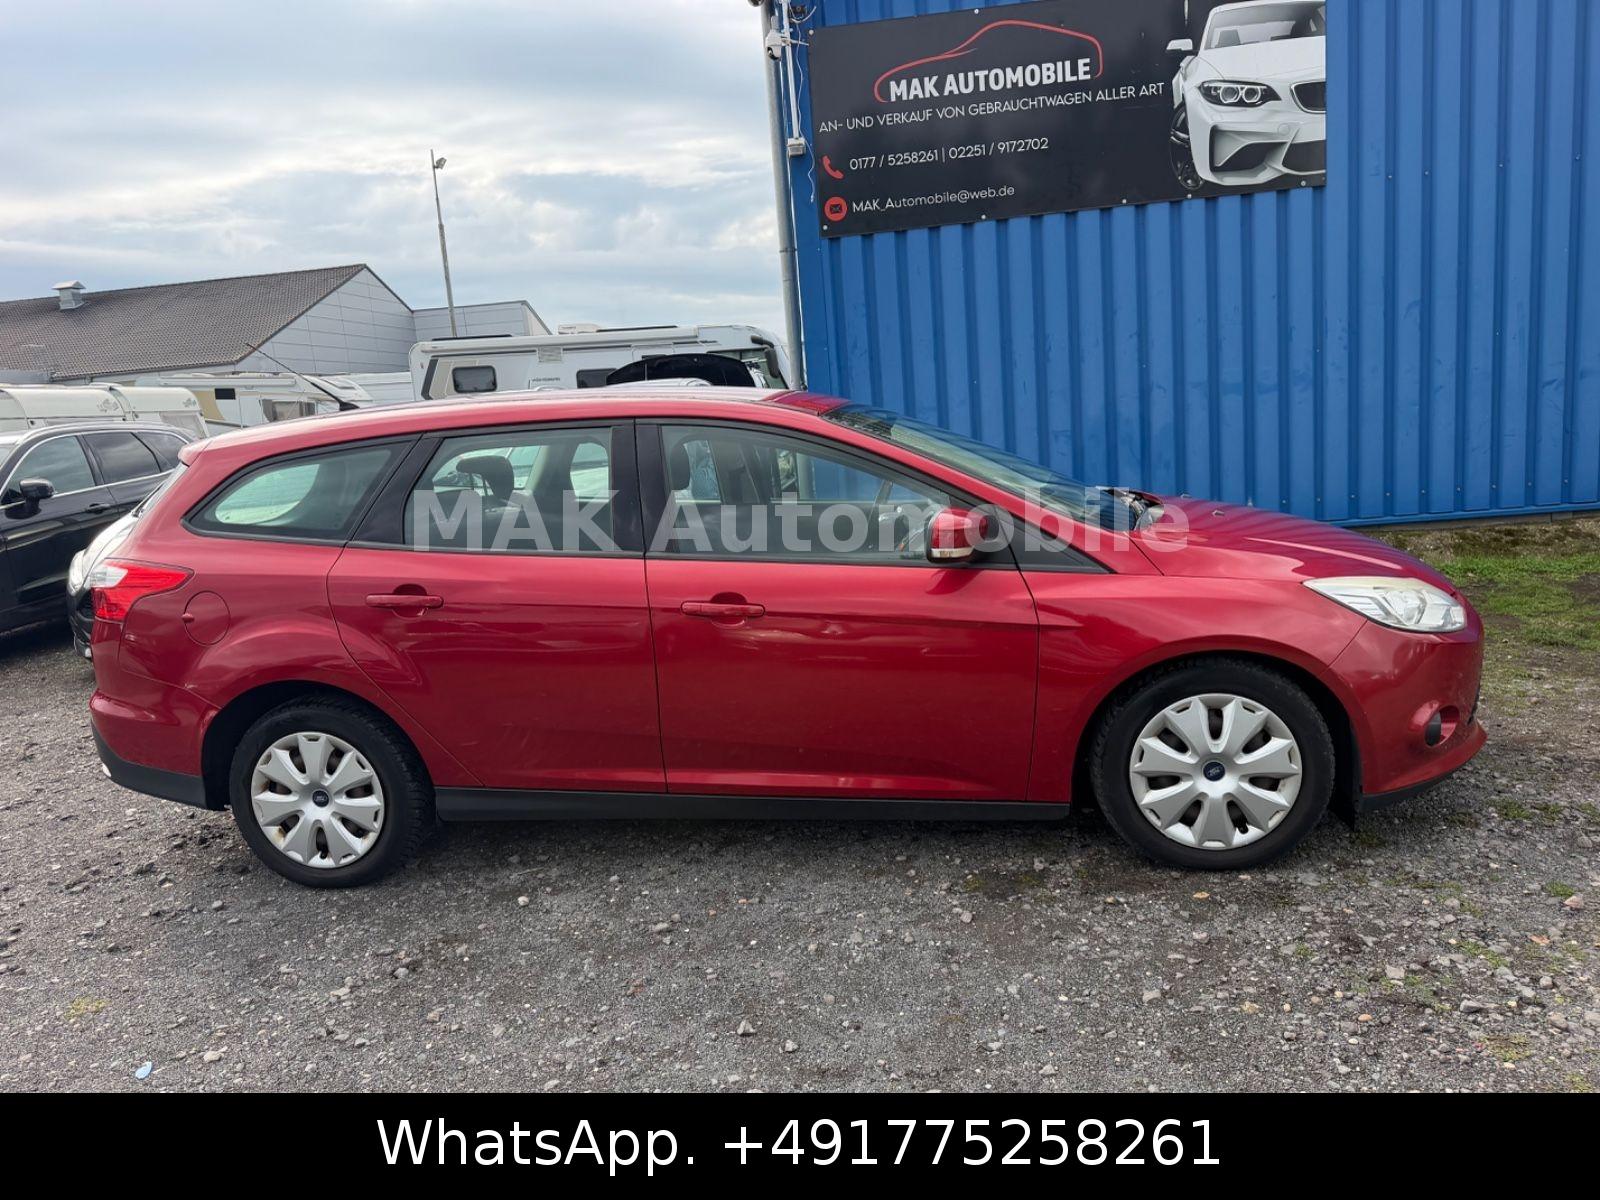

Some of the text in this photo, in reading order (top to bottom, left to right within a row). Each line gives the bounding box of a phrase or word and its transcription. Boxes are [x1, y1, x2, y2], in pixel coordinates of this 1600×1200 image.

[889, 58, 1091, 102] MAK AUTOMOBILE
[819, 82, 1165, 133] AN- UND VERKAUF VON GEBRAUCHTWAGEN ALLER ART
[850, 156, 876, 171] 0177
[888, 149, 939, 166] 5258261
[948, 144, 986, 160] 02251
[997, 137, 1049, 154] 9172702
[852, 185, 1015, 213] MAK_Automobile@web.de
